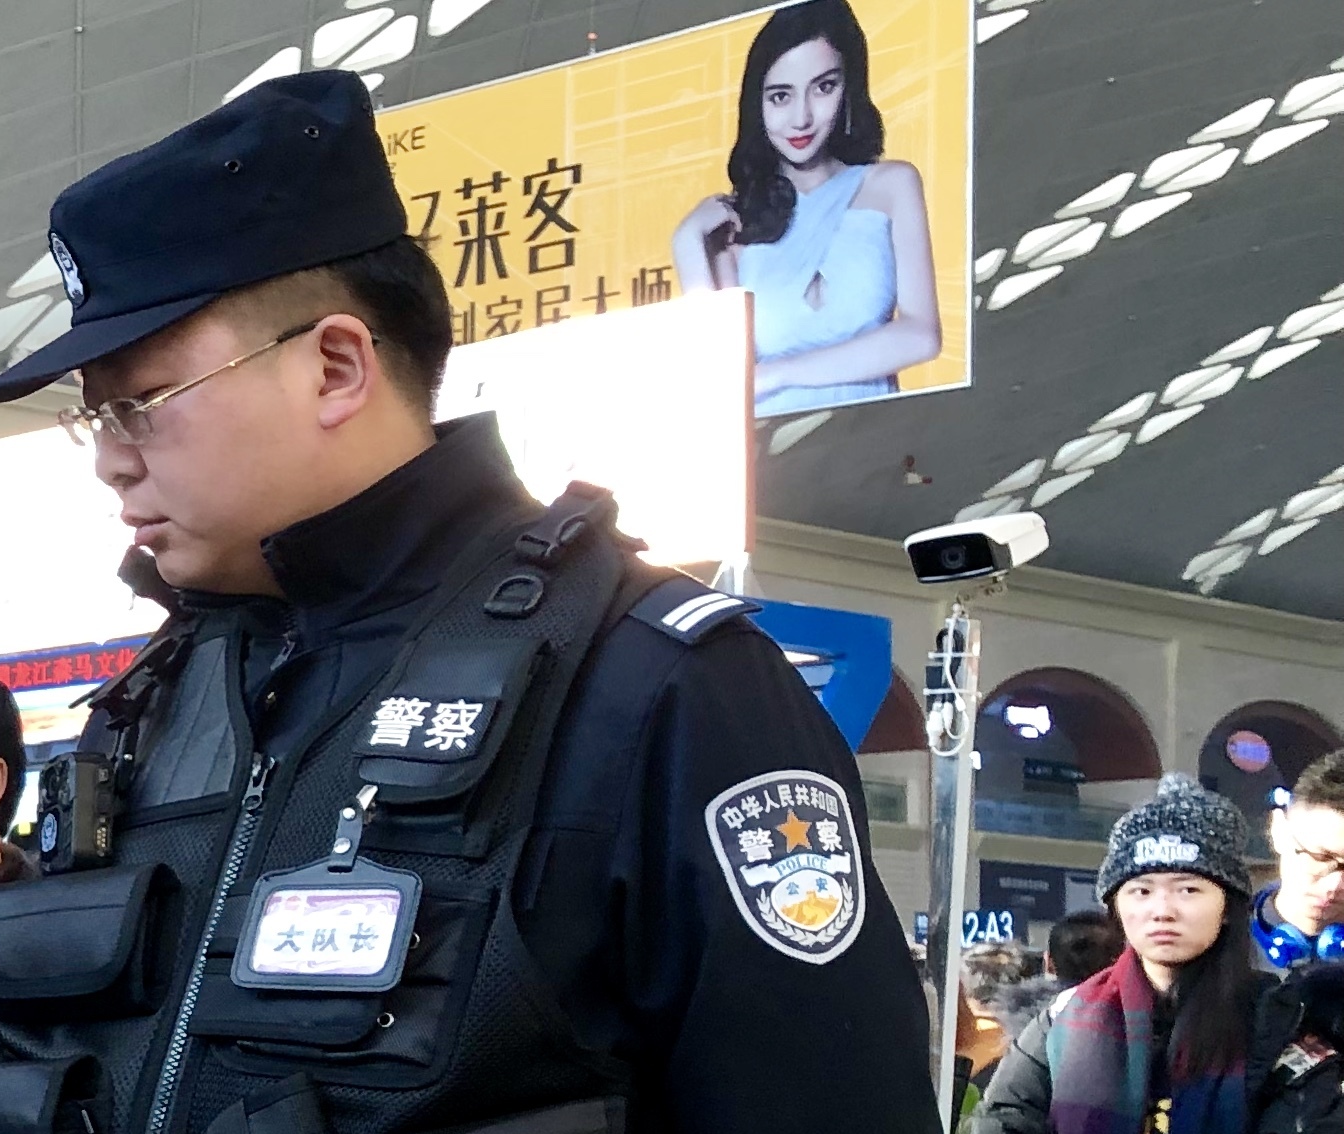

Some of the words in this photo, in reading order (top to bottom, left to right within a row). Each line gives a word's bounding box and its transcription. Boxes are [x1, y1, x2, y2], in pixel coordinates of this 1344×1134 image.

[370, 697, 484, 751] 警察
[721, 783, 840, 830] 中华人民共和国
[775, 854, 829, 877] POLICE
[273, 921, 380, 952] 大队长
